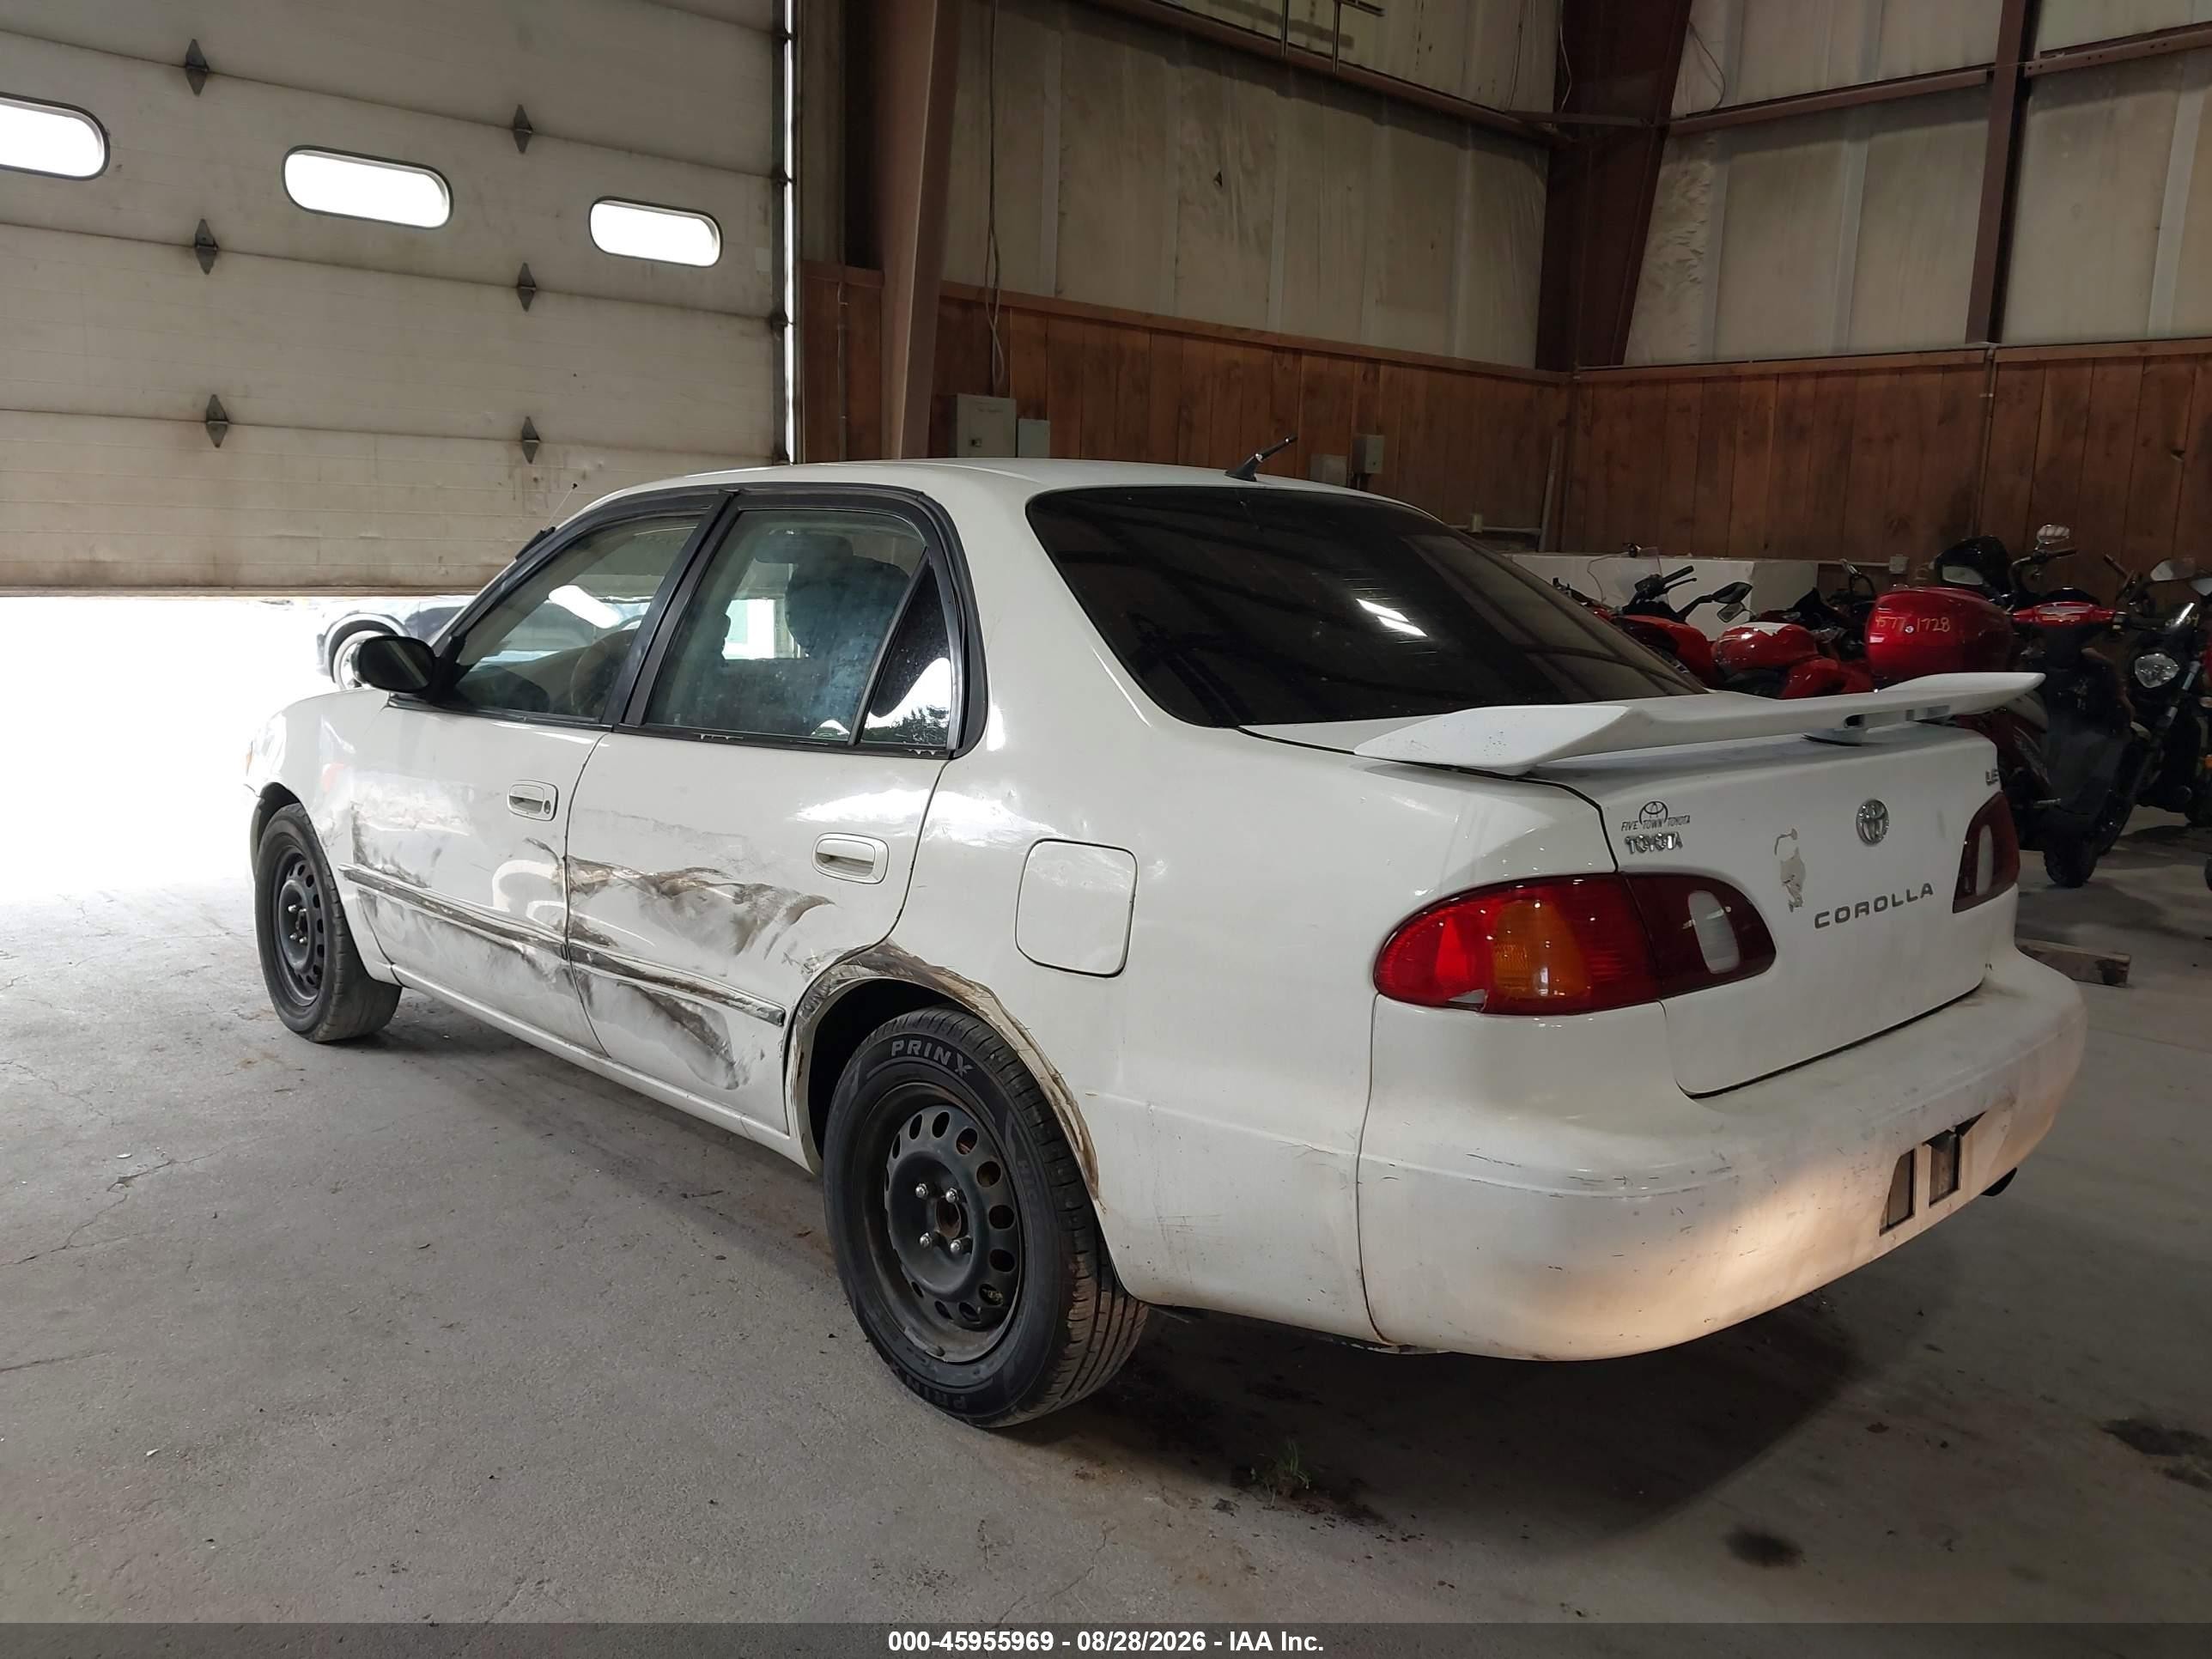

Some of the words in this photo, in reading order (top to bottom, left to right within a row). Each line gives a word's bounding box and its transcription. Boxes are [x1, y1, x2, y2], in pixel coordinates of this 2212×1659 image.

[1916, 617, 1951, 633] 1728
[1620, 820, 1638, 832] FIVE
[1625, 831, 1683, 854] TOYOTA
[1814, 882, 1934, 929] COROLLA
[890, 1039, 975, 1077] PRINX
